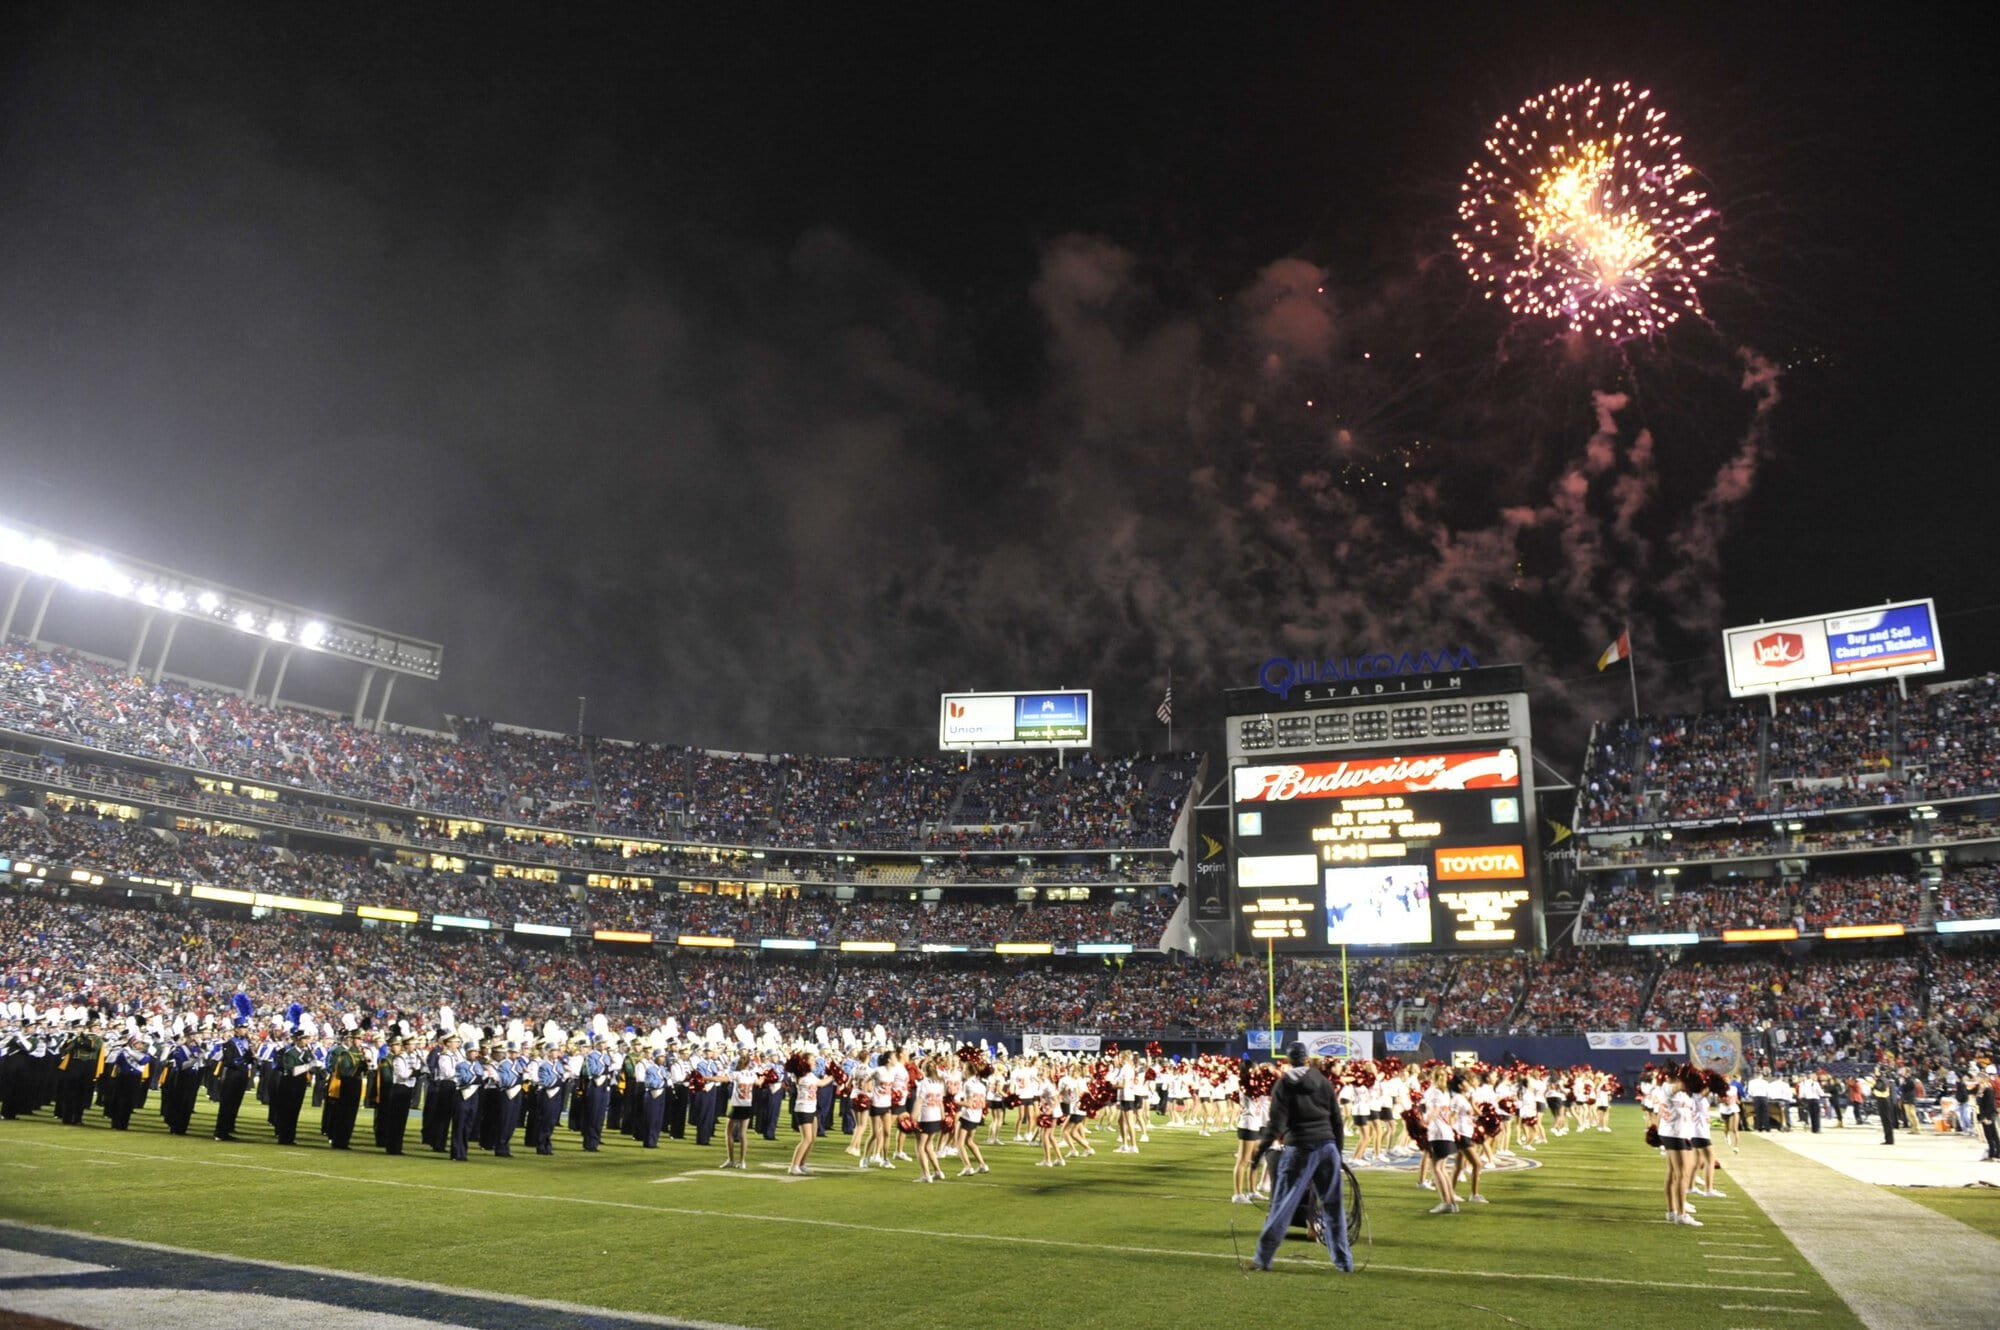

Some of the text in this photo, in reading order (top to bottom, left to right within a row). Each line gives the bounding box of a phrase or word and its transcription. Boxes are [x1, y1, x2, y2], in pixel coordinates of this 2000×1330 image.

[1847, 626, 1912, 645] Buy and Sell
[1836, 636, 1928, 658] Chargers Tickets!
[1260, 647, 1479, 700] QUALCOMM
[1304, 677, 1462, 700] STADIUM
[949, 726, 983, 734] Union
[1264, 757, 1447, 801] Budweiser
[1332, 809, 1414, 826] DR PEPPER
[1197, 862, 1227, 875] Sprint
[1440, 854, 1520, 873] TOYOTA
[1656, 1034, 1679, 1053] N
